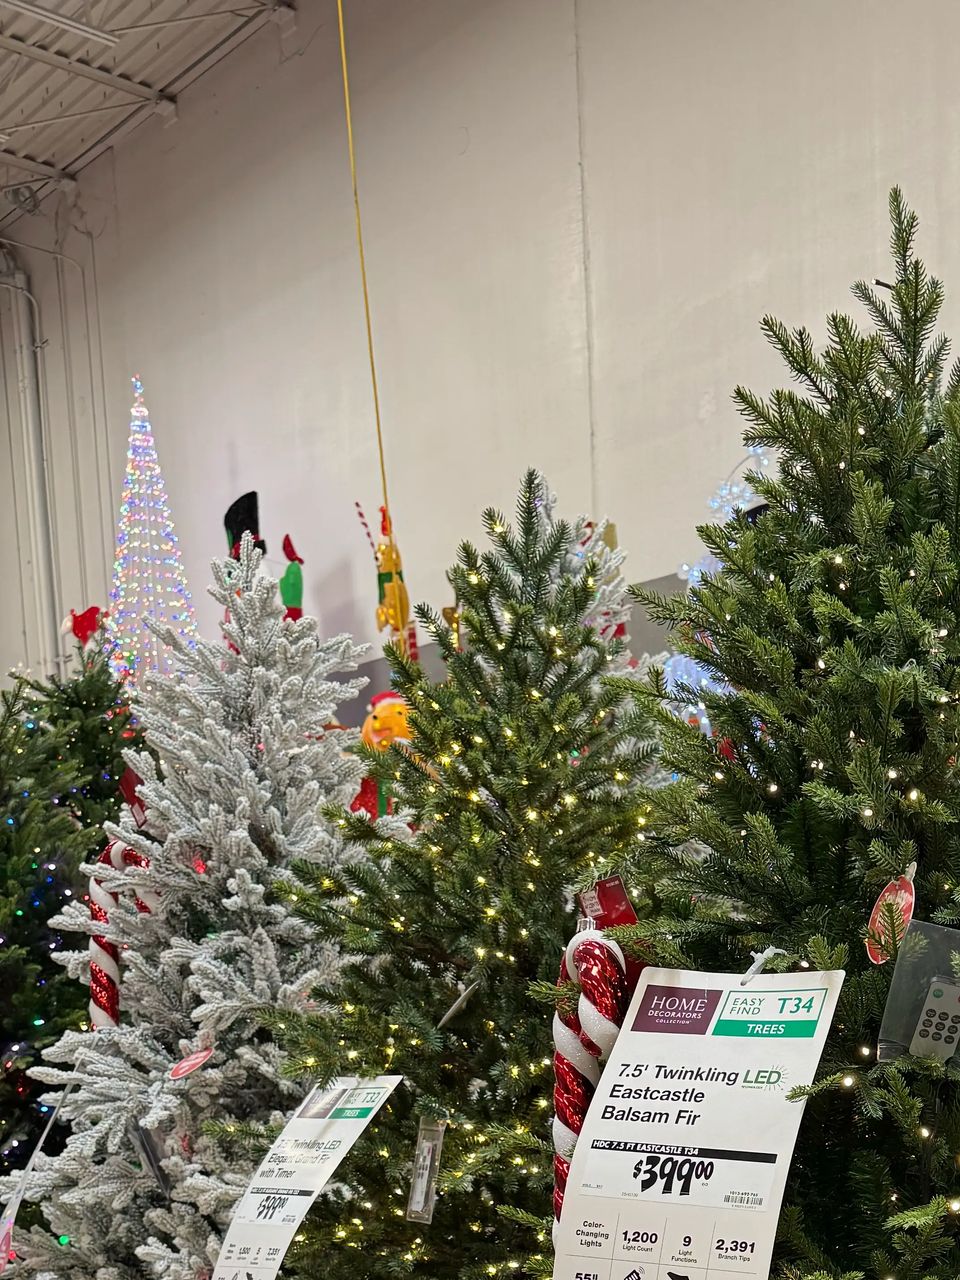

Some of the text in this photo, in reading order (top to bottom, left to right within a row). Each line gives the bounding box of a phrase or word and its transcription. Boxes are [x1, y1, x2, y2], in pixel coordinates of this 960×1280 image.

[651, 996, 707, 1012] HOME
[732, 997, 766, 1006] EASY
[777, 996, 815, 1014] T34
[648, 1010, 702, 1019] DECORATORS
[729, 1007, 761, 1015] FIND
[747, 1024, 785, 1035] TREES
[618, 1063, 782, 1085] 7.5' Twinkling LED
[362, 1092, 380, 1103] T32
[609, 1084, 705, 1104] Eastcastle
[601, 1105, 701, 1126] Balsam Fir
[290, 1139, 342, 1151] Twinkling LED
[593, 1140, 610, 1149] HDC
[637, 1144, 682, 1154] EASTCASTLE
[684, 1147, 699, 1155] T34
[260, 1168, 296, 1178] with Timer
[583, 1220, 605, 1229] Color-
[575, 1229, 610, 1240] Changing
[622, 1230, 658, 1244] 1,200
[580, 1239, 602, 1248] Lights
[682, 1236, 692, 1247] 9
[715, 1239, 756, 1254] 2,391
[622, 1244, 653, 1253] Light Count
[678, 1249, 692, 1257] Light
[671, 1256, 698, 1264] Functions
[718, 1253, 750, 1263] Branch Tips
